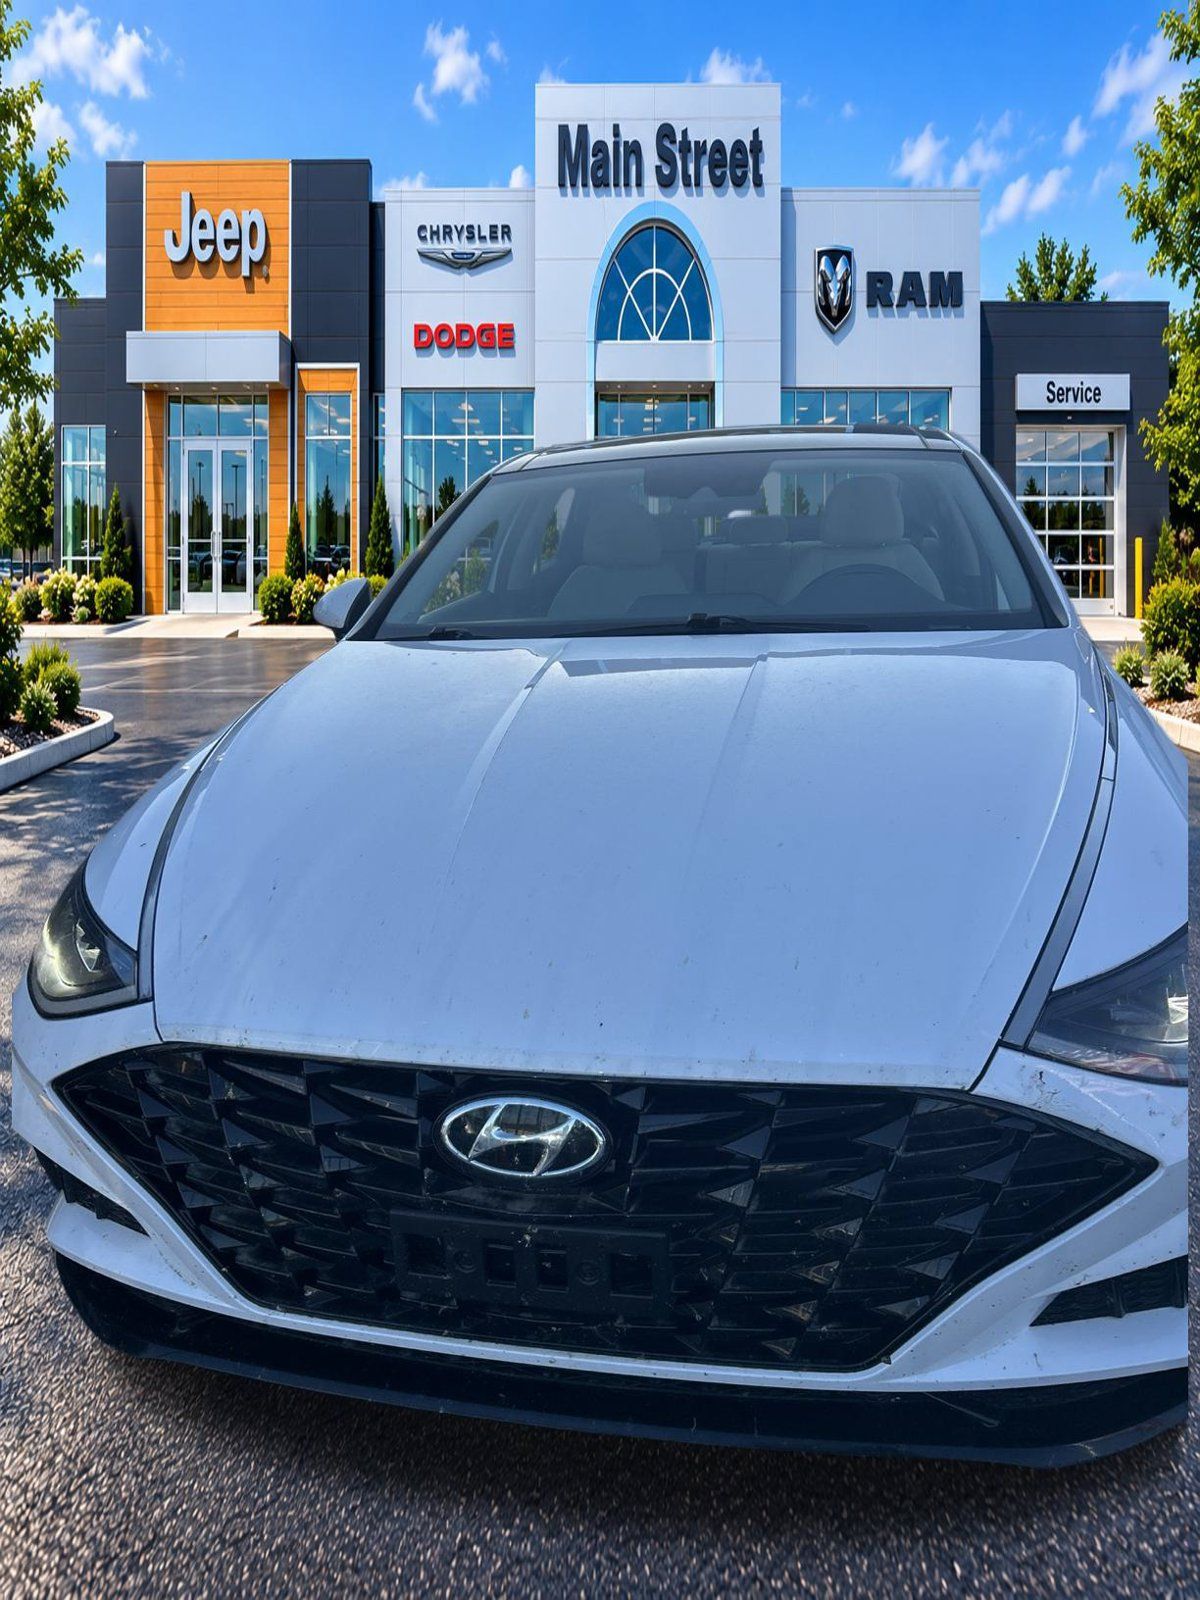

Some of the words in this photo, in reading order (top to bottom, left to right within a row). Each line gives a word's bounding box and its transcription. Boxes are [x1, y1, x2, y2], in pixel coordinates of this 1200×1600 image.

[556, 123, 643, 189] Main
[655, 122, 764, 188] Street
[164, 191, 267, 278] Jeep
[417, 224, 512, 242] CHRYSLER
[866, 271, 964, 308] RAM
[414, 323, 515, 349] DODGE
[1046, 381, 1102, 403] Service
